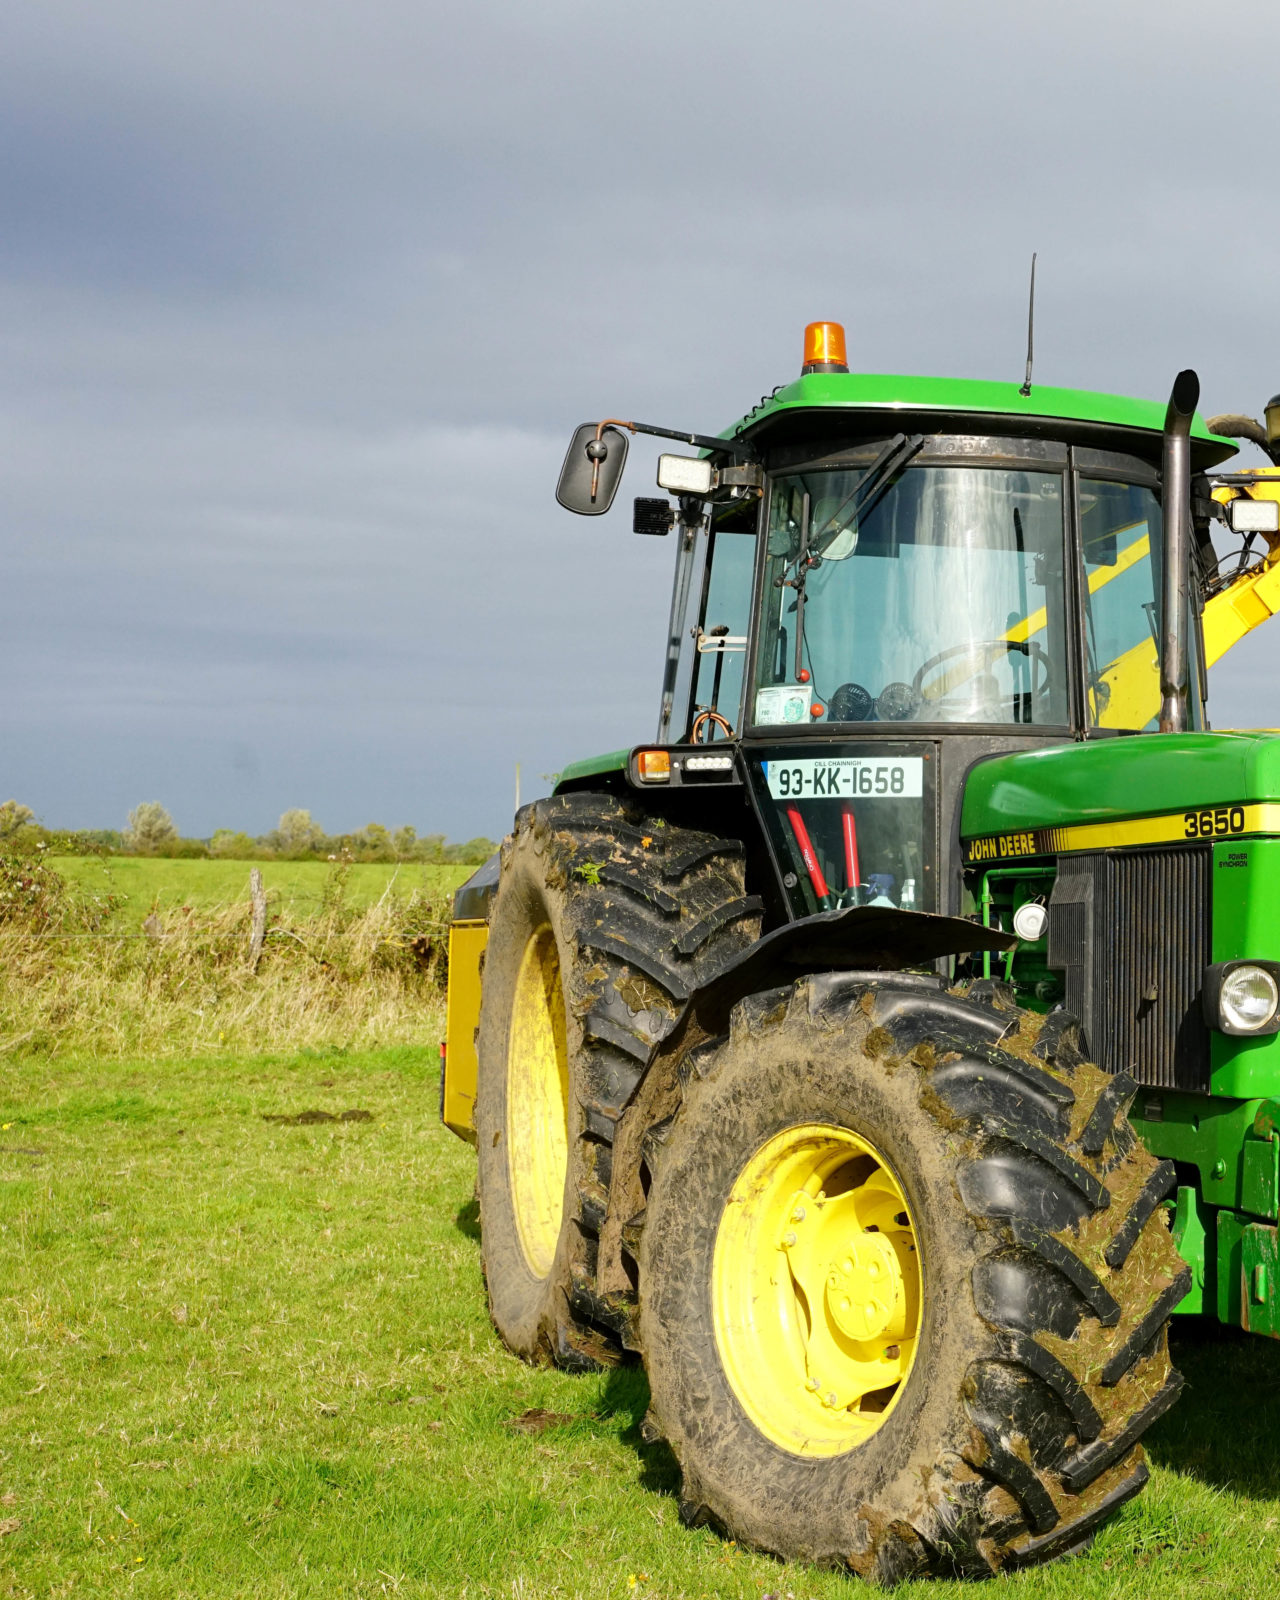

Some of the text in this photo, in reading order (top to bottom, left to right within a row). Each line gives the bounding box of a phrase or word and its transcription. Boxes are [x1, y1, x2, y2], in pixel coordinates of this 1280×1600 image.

[779, 767, 905, 796] 93-KK-1658
[1184, 807, 1245, 838] 3650
[969, 833, 1036, 861] JOHN DEERE
